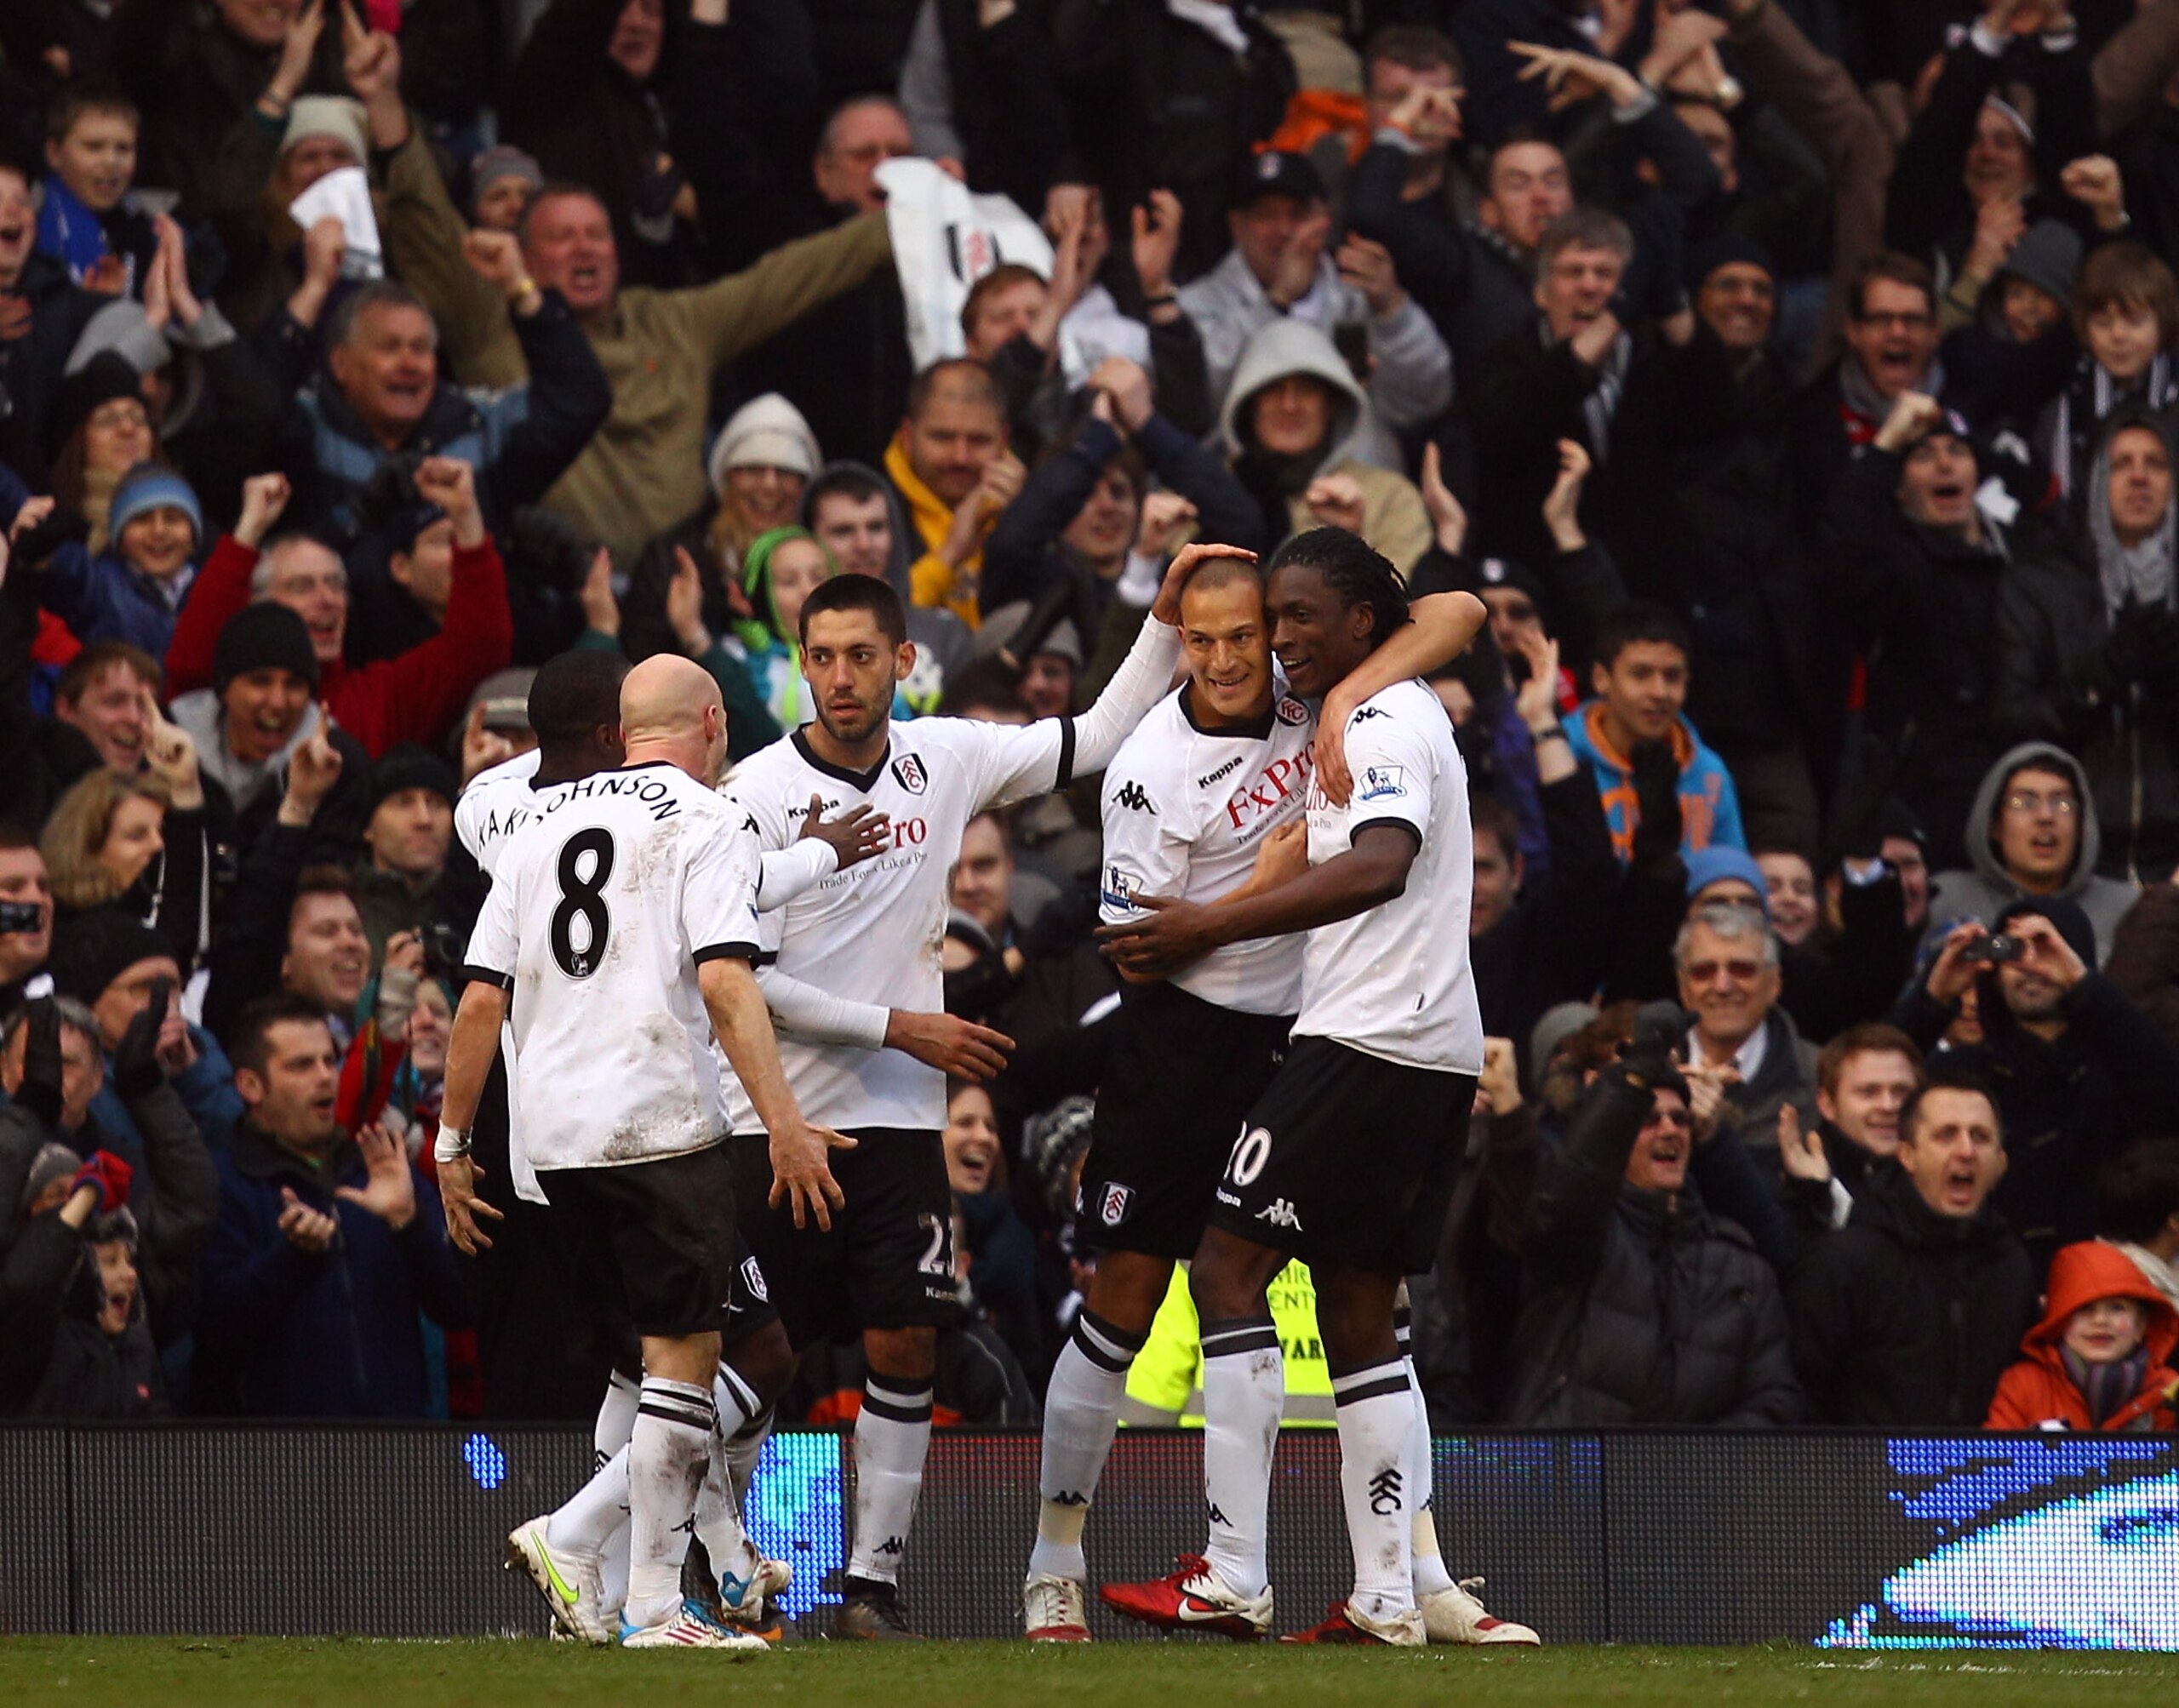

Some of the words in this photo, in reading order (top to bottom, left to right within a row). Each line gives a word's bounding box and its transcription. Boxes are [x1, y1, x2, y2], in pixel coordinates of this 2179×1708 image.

[1198, 756, 1244, 790] Kappa
[787, 798, 841, 819] Kapa
[547, 825, 616, 980] 8
[1224, 1120, 1273, 1186] 0
